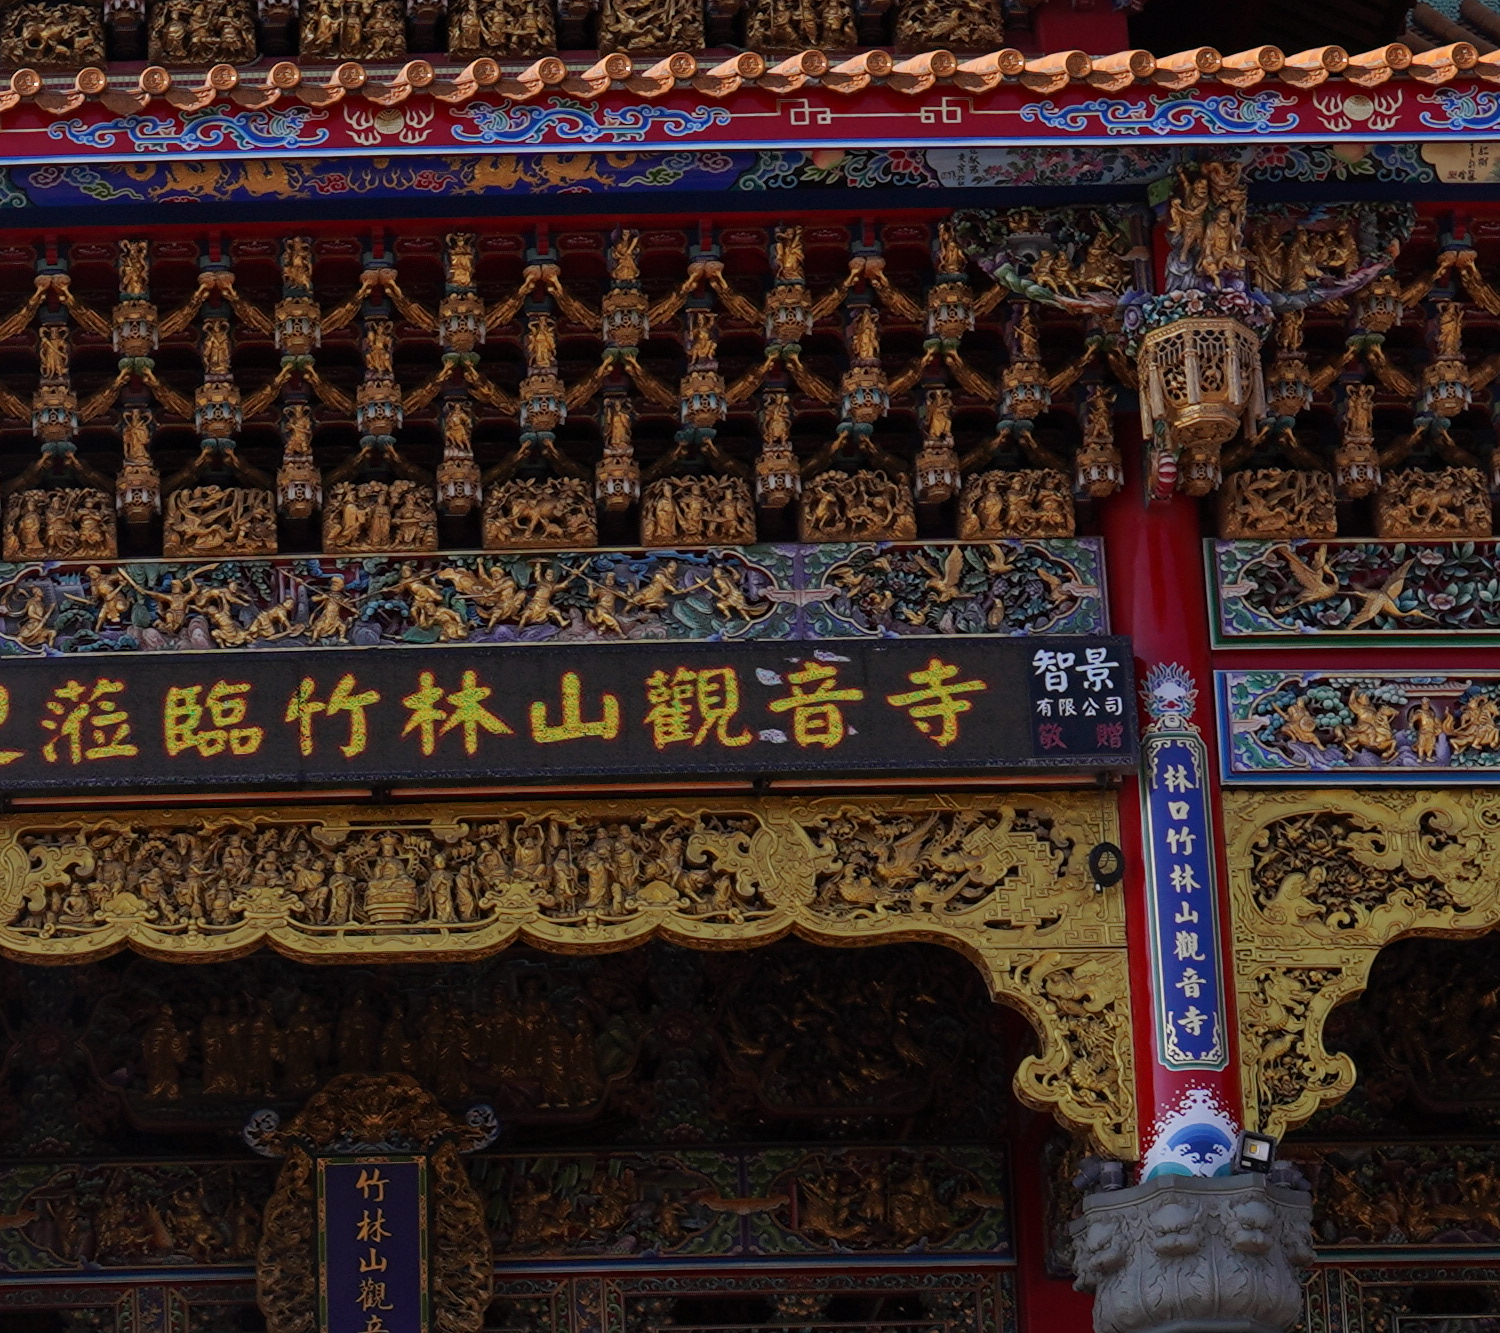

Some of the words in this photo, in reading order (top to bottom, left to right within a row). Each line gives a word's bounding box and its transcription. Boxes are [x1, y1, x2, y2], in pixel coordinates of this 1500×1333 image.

[1032, 647, 1119, 693] 智景
[1036, 697, 1123, 717] 有限公司
[1163, 764, 1209, 1037] 林口竹林山觀音寺
